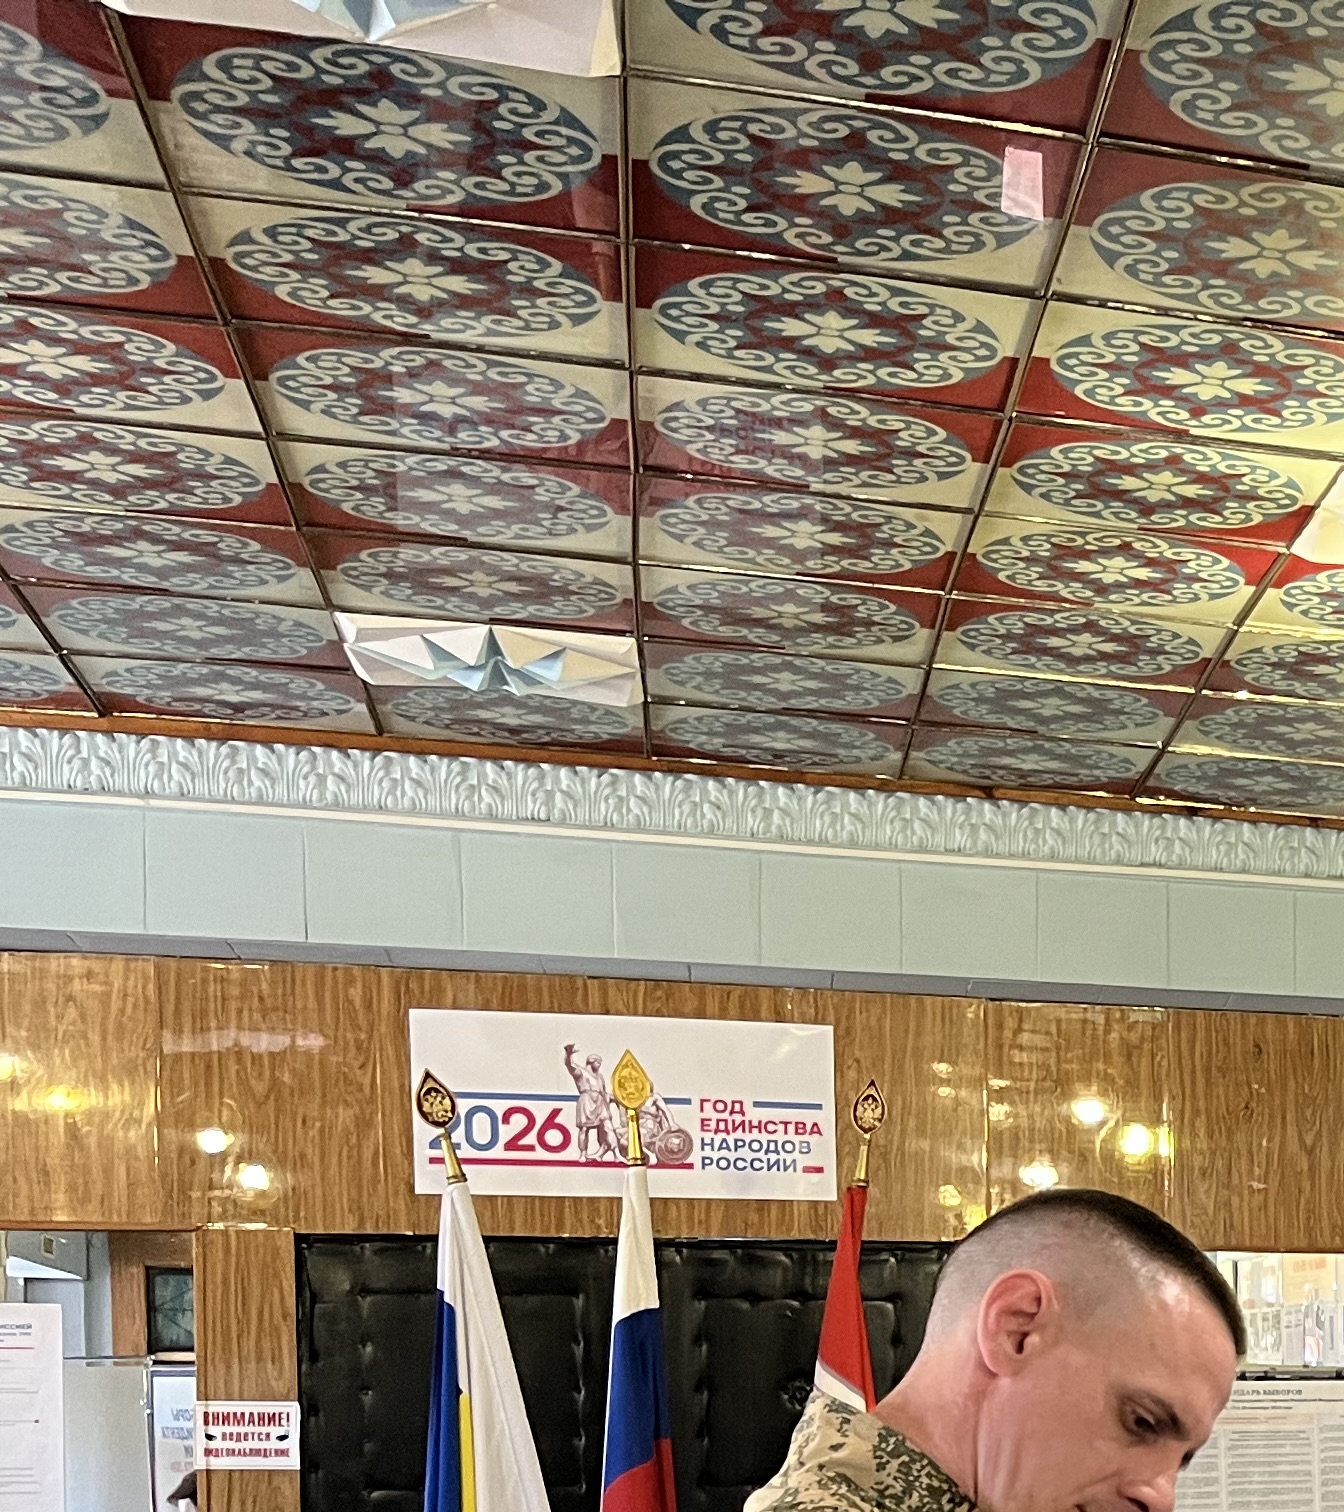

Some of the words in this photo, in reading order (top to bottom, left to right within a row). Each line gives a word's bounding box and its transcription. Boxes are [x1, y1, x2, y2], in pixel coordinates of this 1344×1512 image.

[700, 1098, 745, 1117] ГОД
[700, 1118, 823, 1137] ЕДИНСТВА
[700, 1137, 811, 1156] НАРОДОВ
[700, 1156, 797, 1173] РОССИИ
[203, 1411, 290, 1427] ВНИМАНИЕ!
